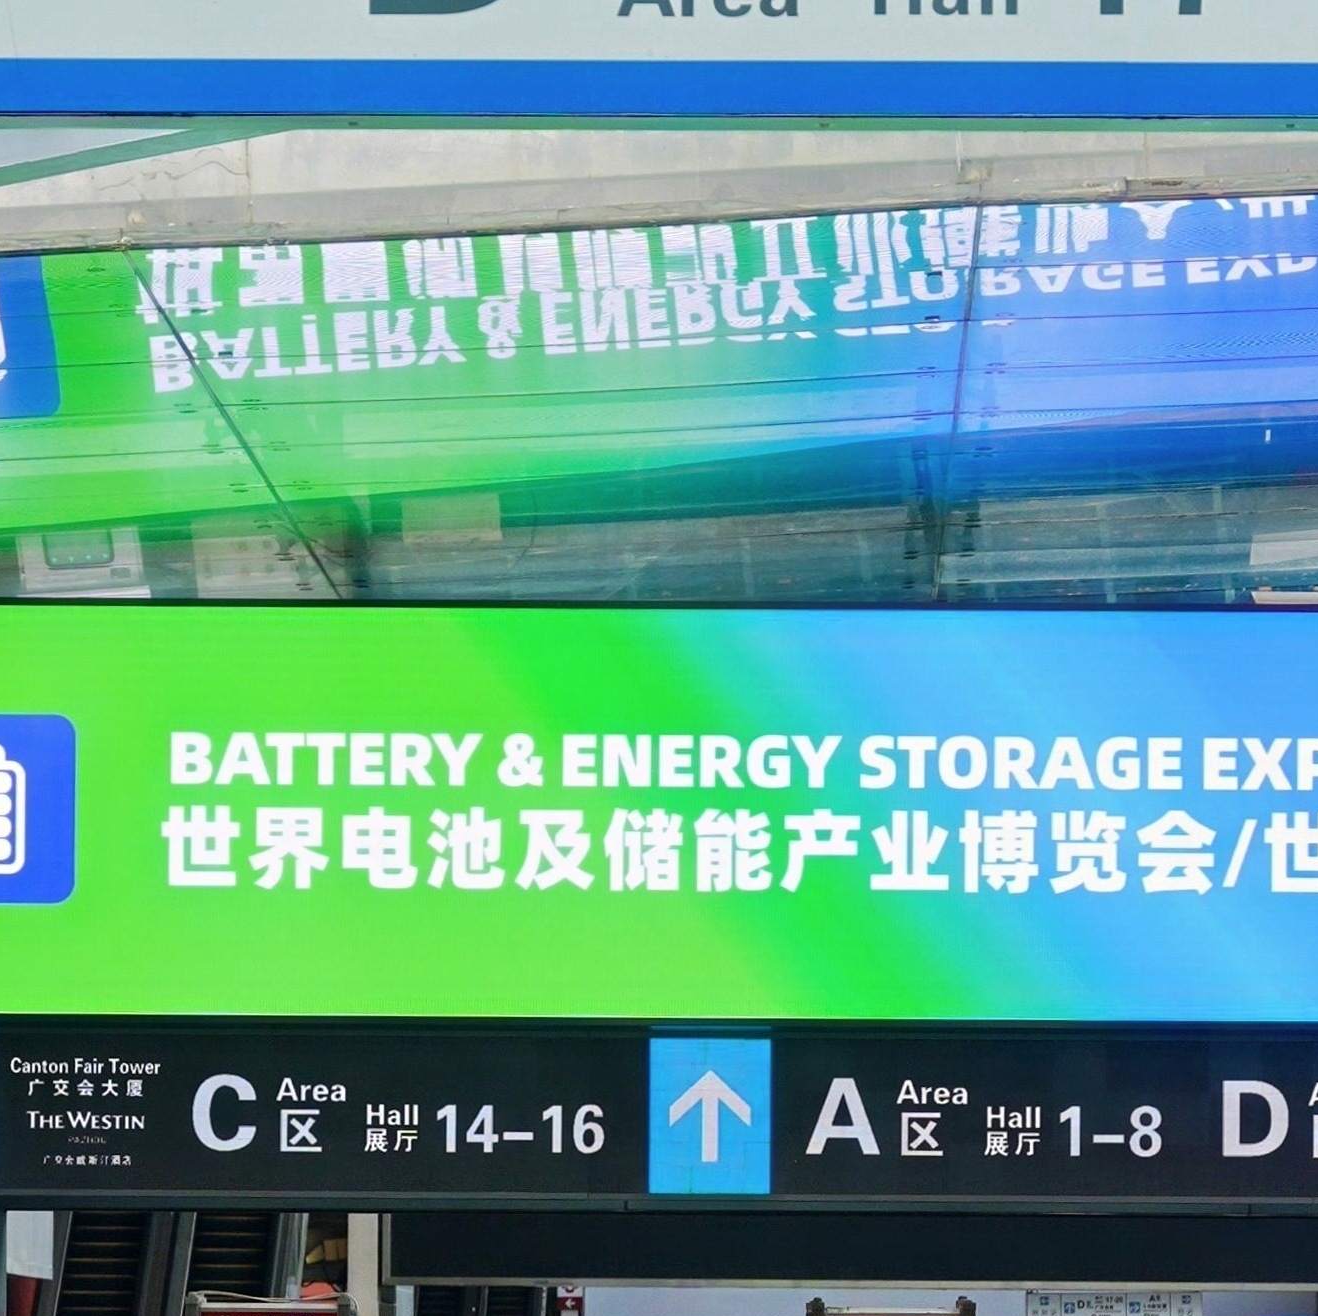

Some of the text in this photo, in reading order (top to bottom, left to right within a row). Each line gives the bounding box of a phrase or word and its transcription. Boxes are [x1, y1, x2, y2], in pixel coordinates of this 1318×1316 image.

[170, 730, 482, 786] BATTERY
[497, 732, 545, 788] &
[562, 734, 844, 789] ENERGY
[858, 735, 1183, 791] STORAGE
[10, 1056, 161, 1075] Canton Fair Tower
[27, 1078, 144, 1097] 广交会大厦
[276, 1077, 347, 1103] Area
[896, 1079, 969, 1105] Area
[26, 1110, 145, 1129] THE WESTIN
[192, 1073, 257, 1153] C
[365, 1103, 420, 1127] Hall
[805, 1077, 881, 1156] A
[986, 1106, 1041, 1129] Hall
[1222, 1080, 1290, 1158] D
[280, 1108, 323, 1153] 区
[364, 1129, 419, 1153] 展厅
[901, 1112, 944, 1156] 区
[984, 1132, 1041, 1157] 展厅
